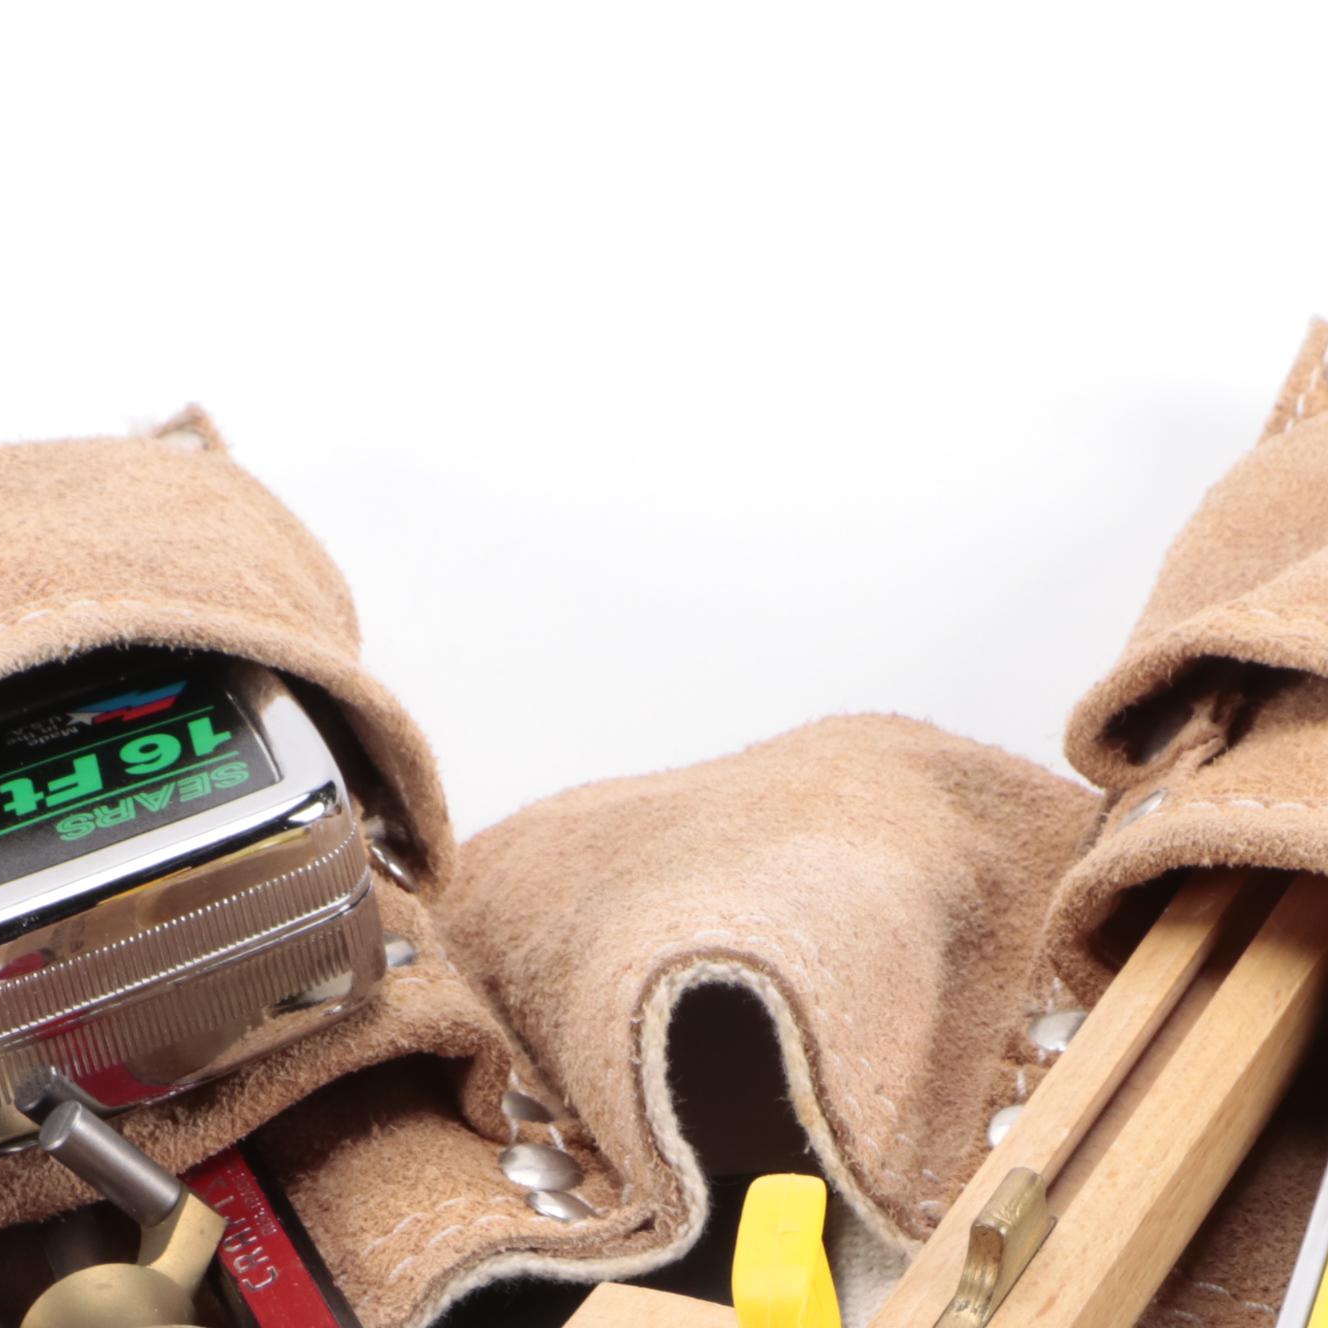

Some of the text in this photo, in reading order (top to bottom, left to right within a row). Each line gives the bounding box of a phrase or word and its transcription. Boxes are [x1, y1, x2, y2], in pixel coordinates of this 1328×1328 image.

[27, 726, 79, 746] Made
[119, 717, 232, 775] 16
[55, 761, 251, 841] SEARS
